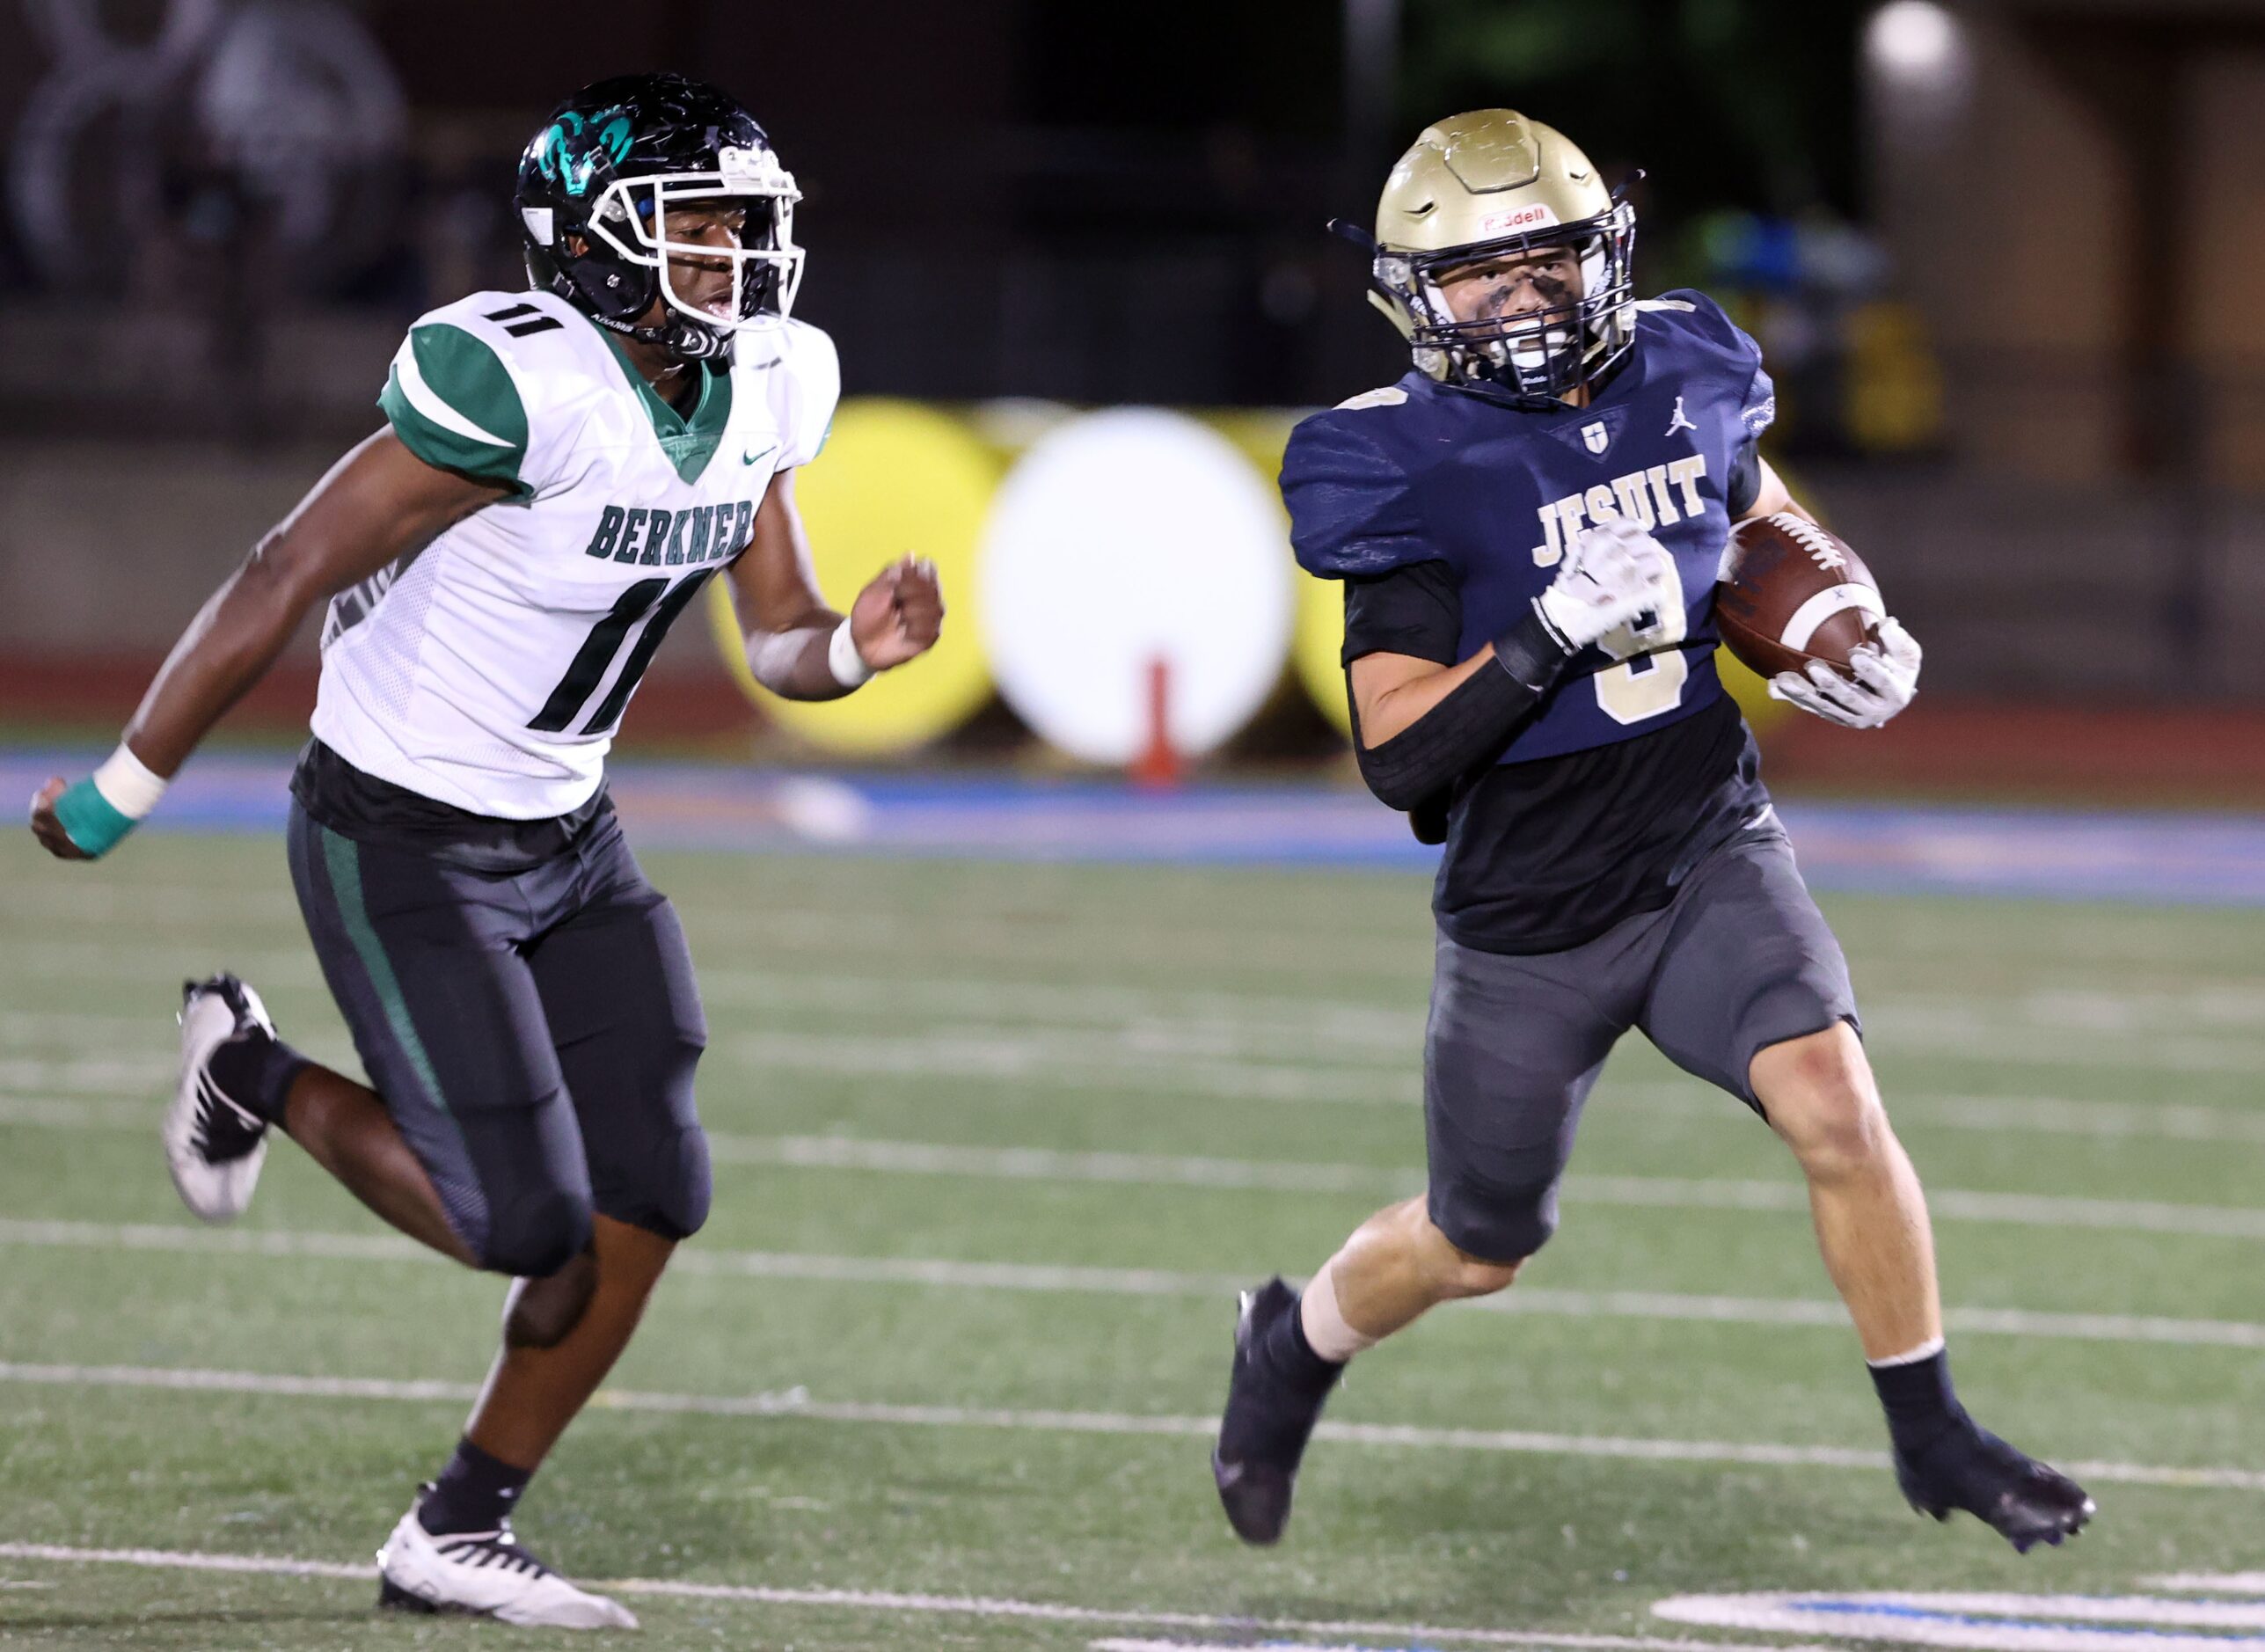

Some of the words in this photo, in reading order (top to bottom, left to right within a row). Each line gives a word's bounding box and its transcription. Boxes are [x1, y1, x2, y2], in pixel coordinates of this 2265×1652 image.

[480, 303, 566, 339] 11
[585, 500, 753, 567] BERKNER
[525, 567, 715, 735] 11
